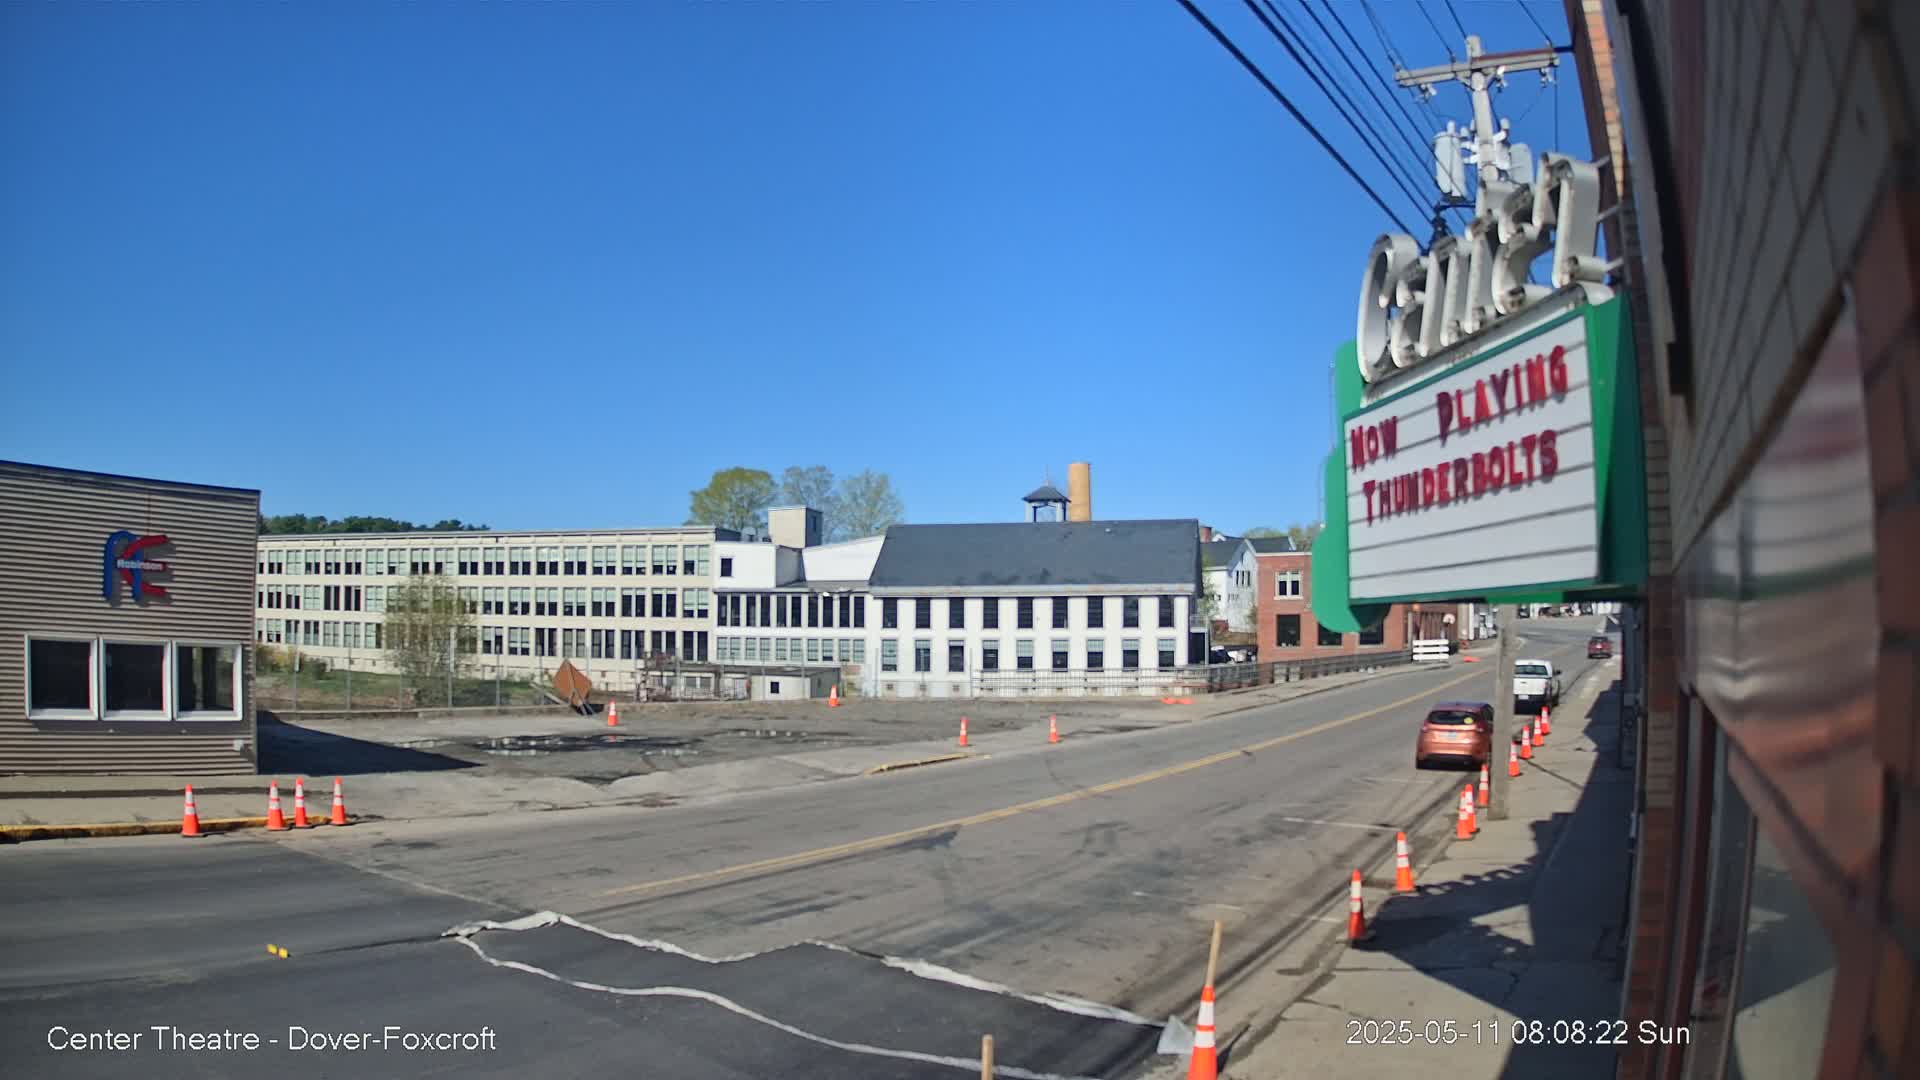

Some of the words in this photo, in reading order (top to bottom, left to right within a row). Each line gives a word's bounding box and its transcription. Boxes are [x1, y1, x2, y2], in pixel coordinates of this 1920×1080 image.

[1351, 416, 1398, 469] NOW
[1436, 345, 1568, 445] PLAYING
[1363, 430, 1559, 524] THUNDERBOLTS
